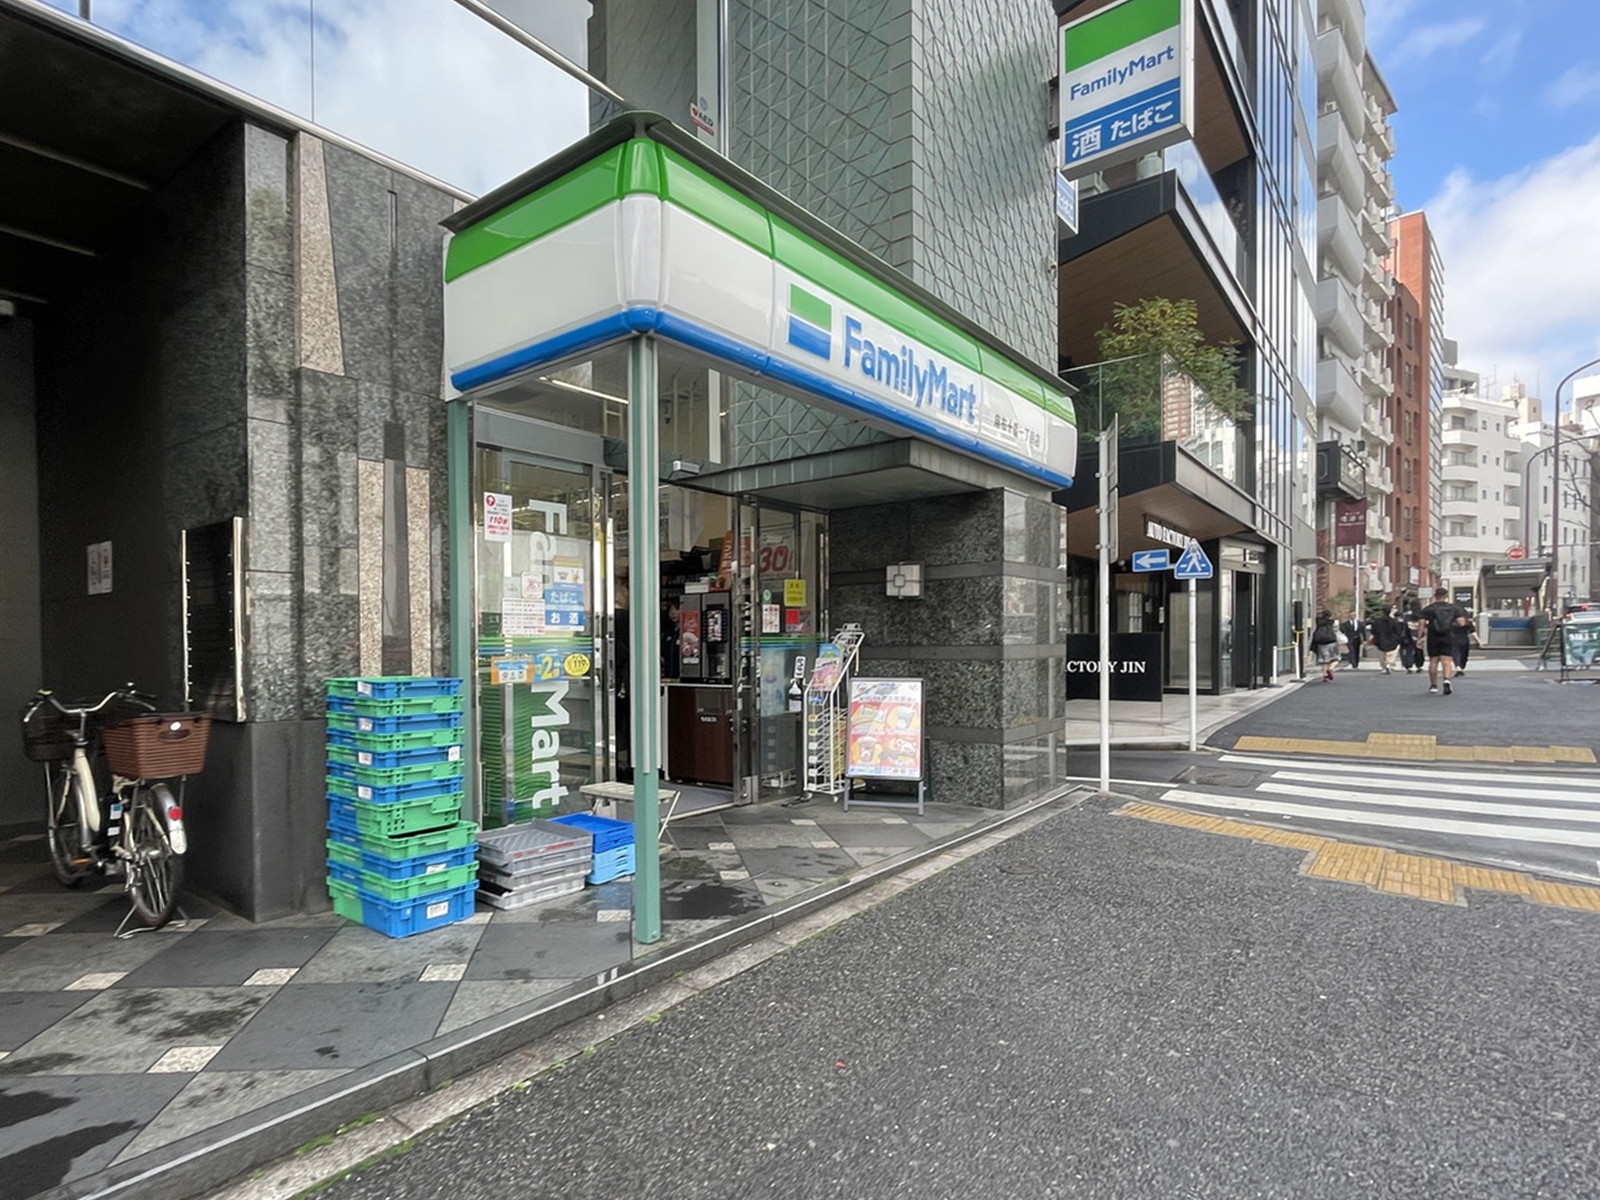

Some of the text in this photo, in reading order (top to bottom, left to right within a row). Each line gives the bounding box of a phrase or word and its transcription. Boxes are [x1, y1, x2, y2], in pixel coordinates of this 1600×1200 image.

[1070, 45, 1174, 101] FamilyMart
[1071, 101, 1174, 158] 酒 たばこ
[844, 315, 976, 425] FamilyMart
[550, 591, 579, 604] たばこ
[1120, 661, 1146, 673] JIN
